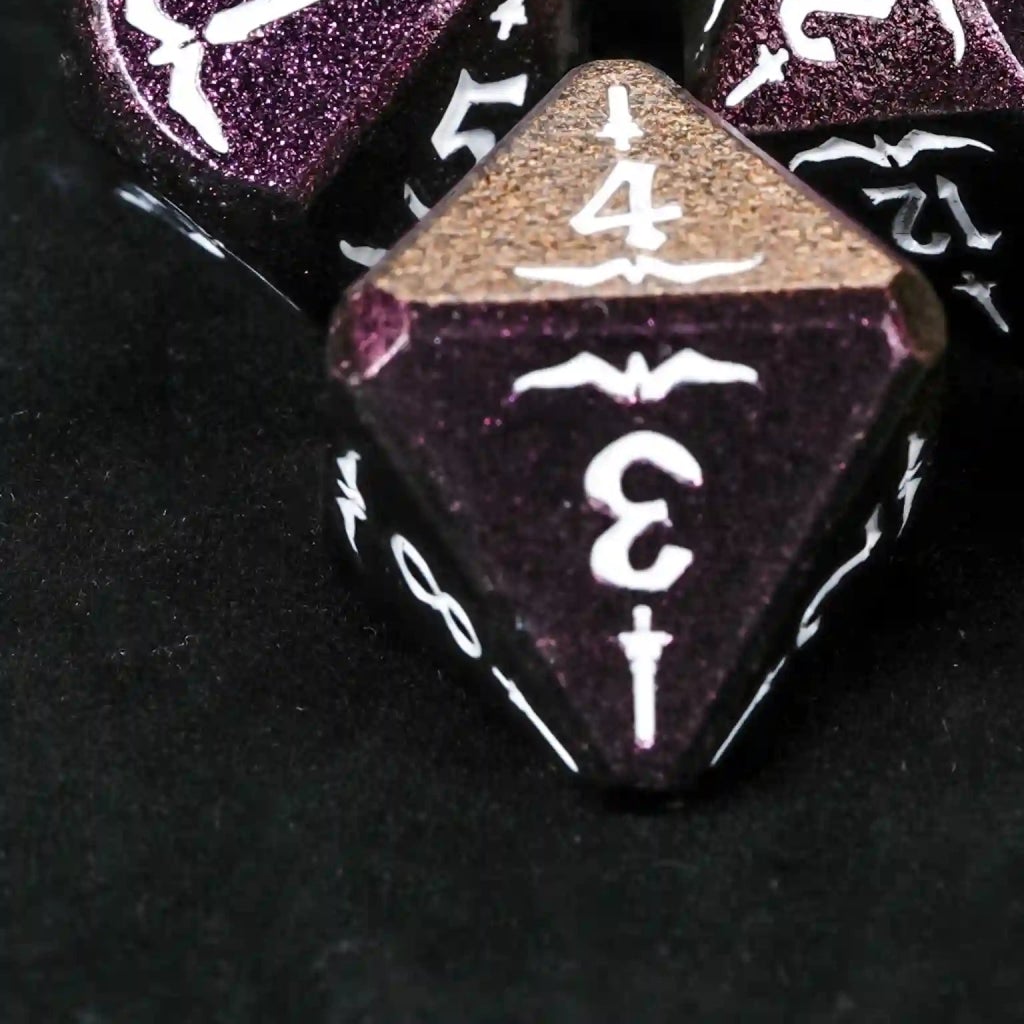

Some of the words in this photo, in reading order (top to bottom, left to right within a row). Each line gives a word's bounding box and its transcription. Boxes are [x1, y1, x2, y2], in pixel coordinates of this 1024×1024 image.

[569, 160, 683, 251] 4
[862, 174, 1003, 257] 12
[584, 430, 704, 593] 3
[390, 533, 483, 659] 8
